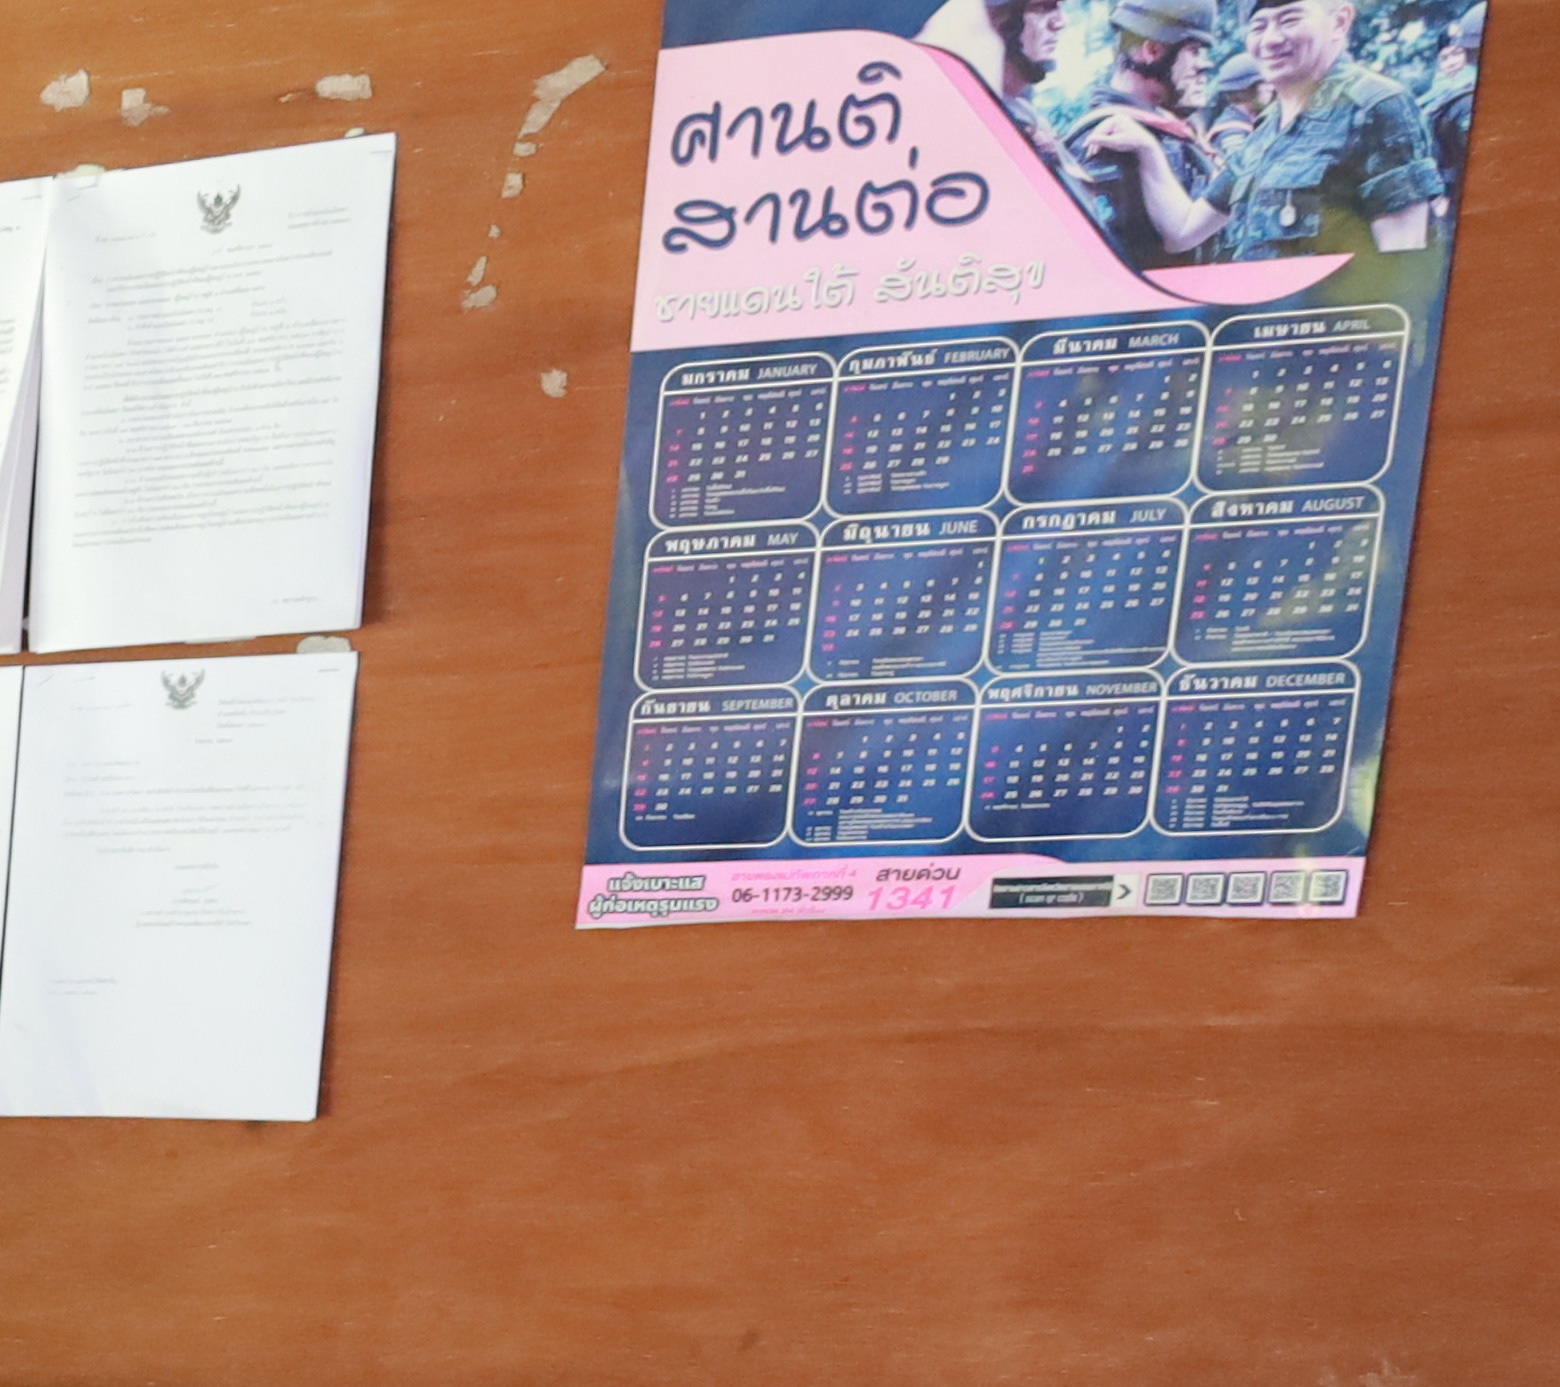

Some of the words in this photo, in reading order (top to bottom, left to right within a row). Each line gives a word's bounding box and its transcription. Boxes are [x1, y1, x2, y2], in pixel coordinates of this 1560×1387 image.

[671, 60, 902, 166] ศานติ
[661, 146, 990, 253] สานต่อ
[654, 263, 859, 322] ชายแดนใต้
[873, 251, 1046, 304] สันติสุข
[1253, 320, 1326, 338] เมษายน
[1332, 319, 1371, 333] APRIL
[1053, 335, 1117, 355] มีนาคม
[1128, 332, 1179, 349] MARCH
[849, 348, 938, 373] กุมภาพันธ์
[943, 347, 1011, 363] FEBRUARY
[681, 368, 750, 386] มกราคม
[756, 363, 818, 380] JANUARY
[1211, 499, 1293, 519] สิงหาคม
[1301, 496, 1365, 512] AUGUST
[1022, 510, 1116, 531] กรกฎาคม
[1129, 508, 1167, 524] JULY
[665, 534, 756, 553] พฤษภาคม
[767, 533, 799, 546] MAY
[844, 522, 931, 544] มิถุนายน
[939, 520, 978, 536] JUNE
[988, 683, 1079, 702] พฤศจิกายน
[1085, 681, 1158, 696] NOVEMBER
[1179, 673, 1258, 692] ธันวาคม
[1265, 672, 1345, 687] DECEMBER
[640, 699, 710, 716] กันยายน
[722, 697, 793, 712] SEPTEMBER
[826, 693, 887, 711] ตุลาคม
[893, 690, 957, 704] OCTOBER
[607, 872, 706, 893] แจ้งเบาะแส
[876, 863, 961, 883] สายด่วน
[732, 886, 854, 903] 06-1173-2999
[868, 885, 957, 911] 1341
